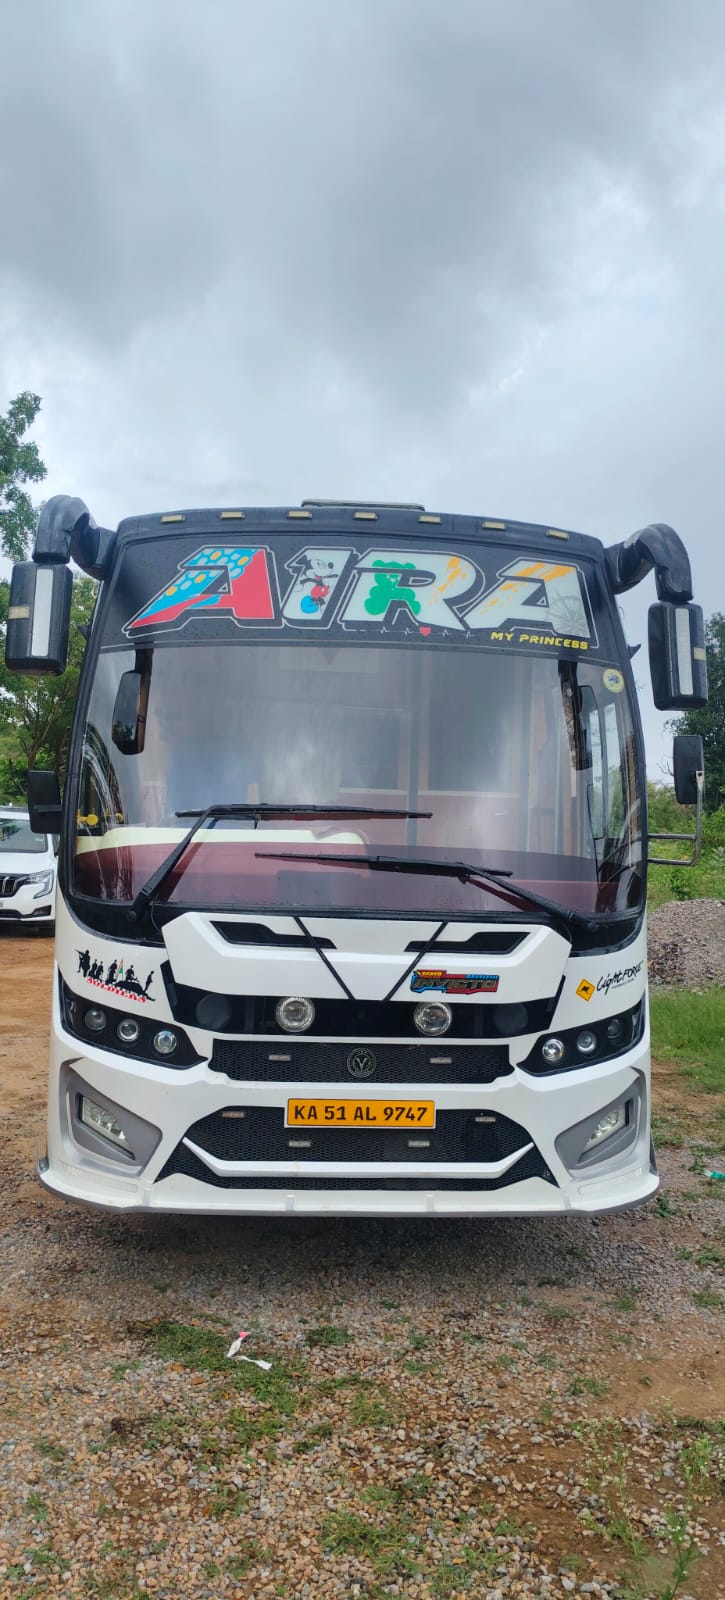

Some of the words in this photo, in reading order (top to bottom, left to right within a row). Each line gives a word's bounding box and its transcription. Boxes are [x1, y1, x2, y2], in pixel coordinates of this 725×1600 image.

[126, 546, 594, 637] AIRA
[490, 632, 514, 640] MY
[519, 634, 588, 650] PRINCESS
[294, 1105, 318, 1120] KA
[324, 1105, 346, 1120] 51
[353, 1106, 376, 1120] AL
[383, 1106, 427, 1121] 9747
